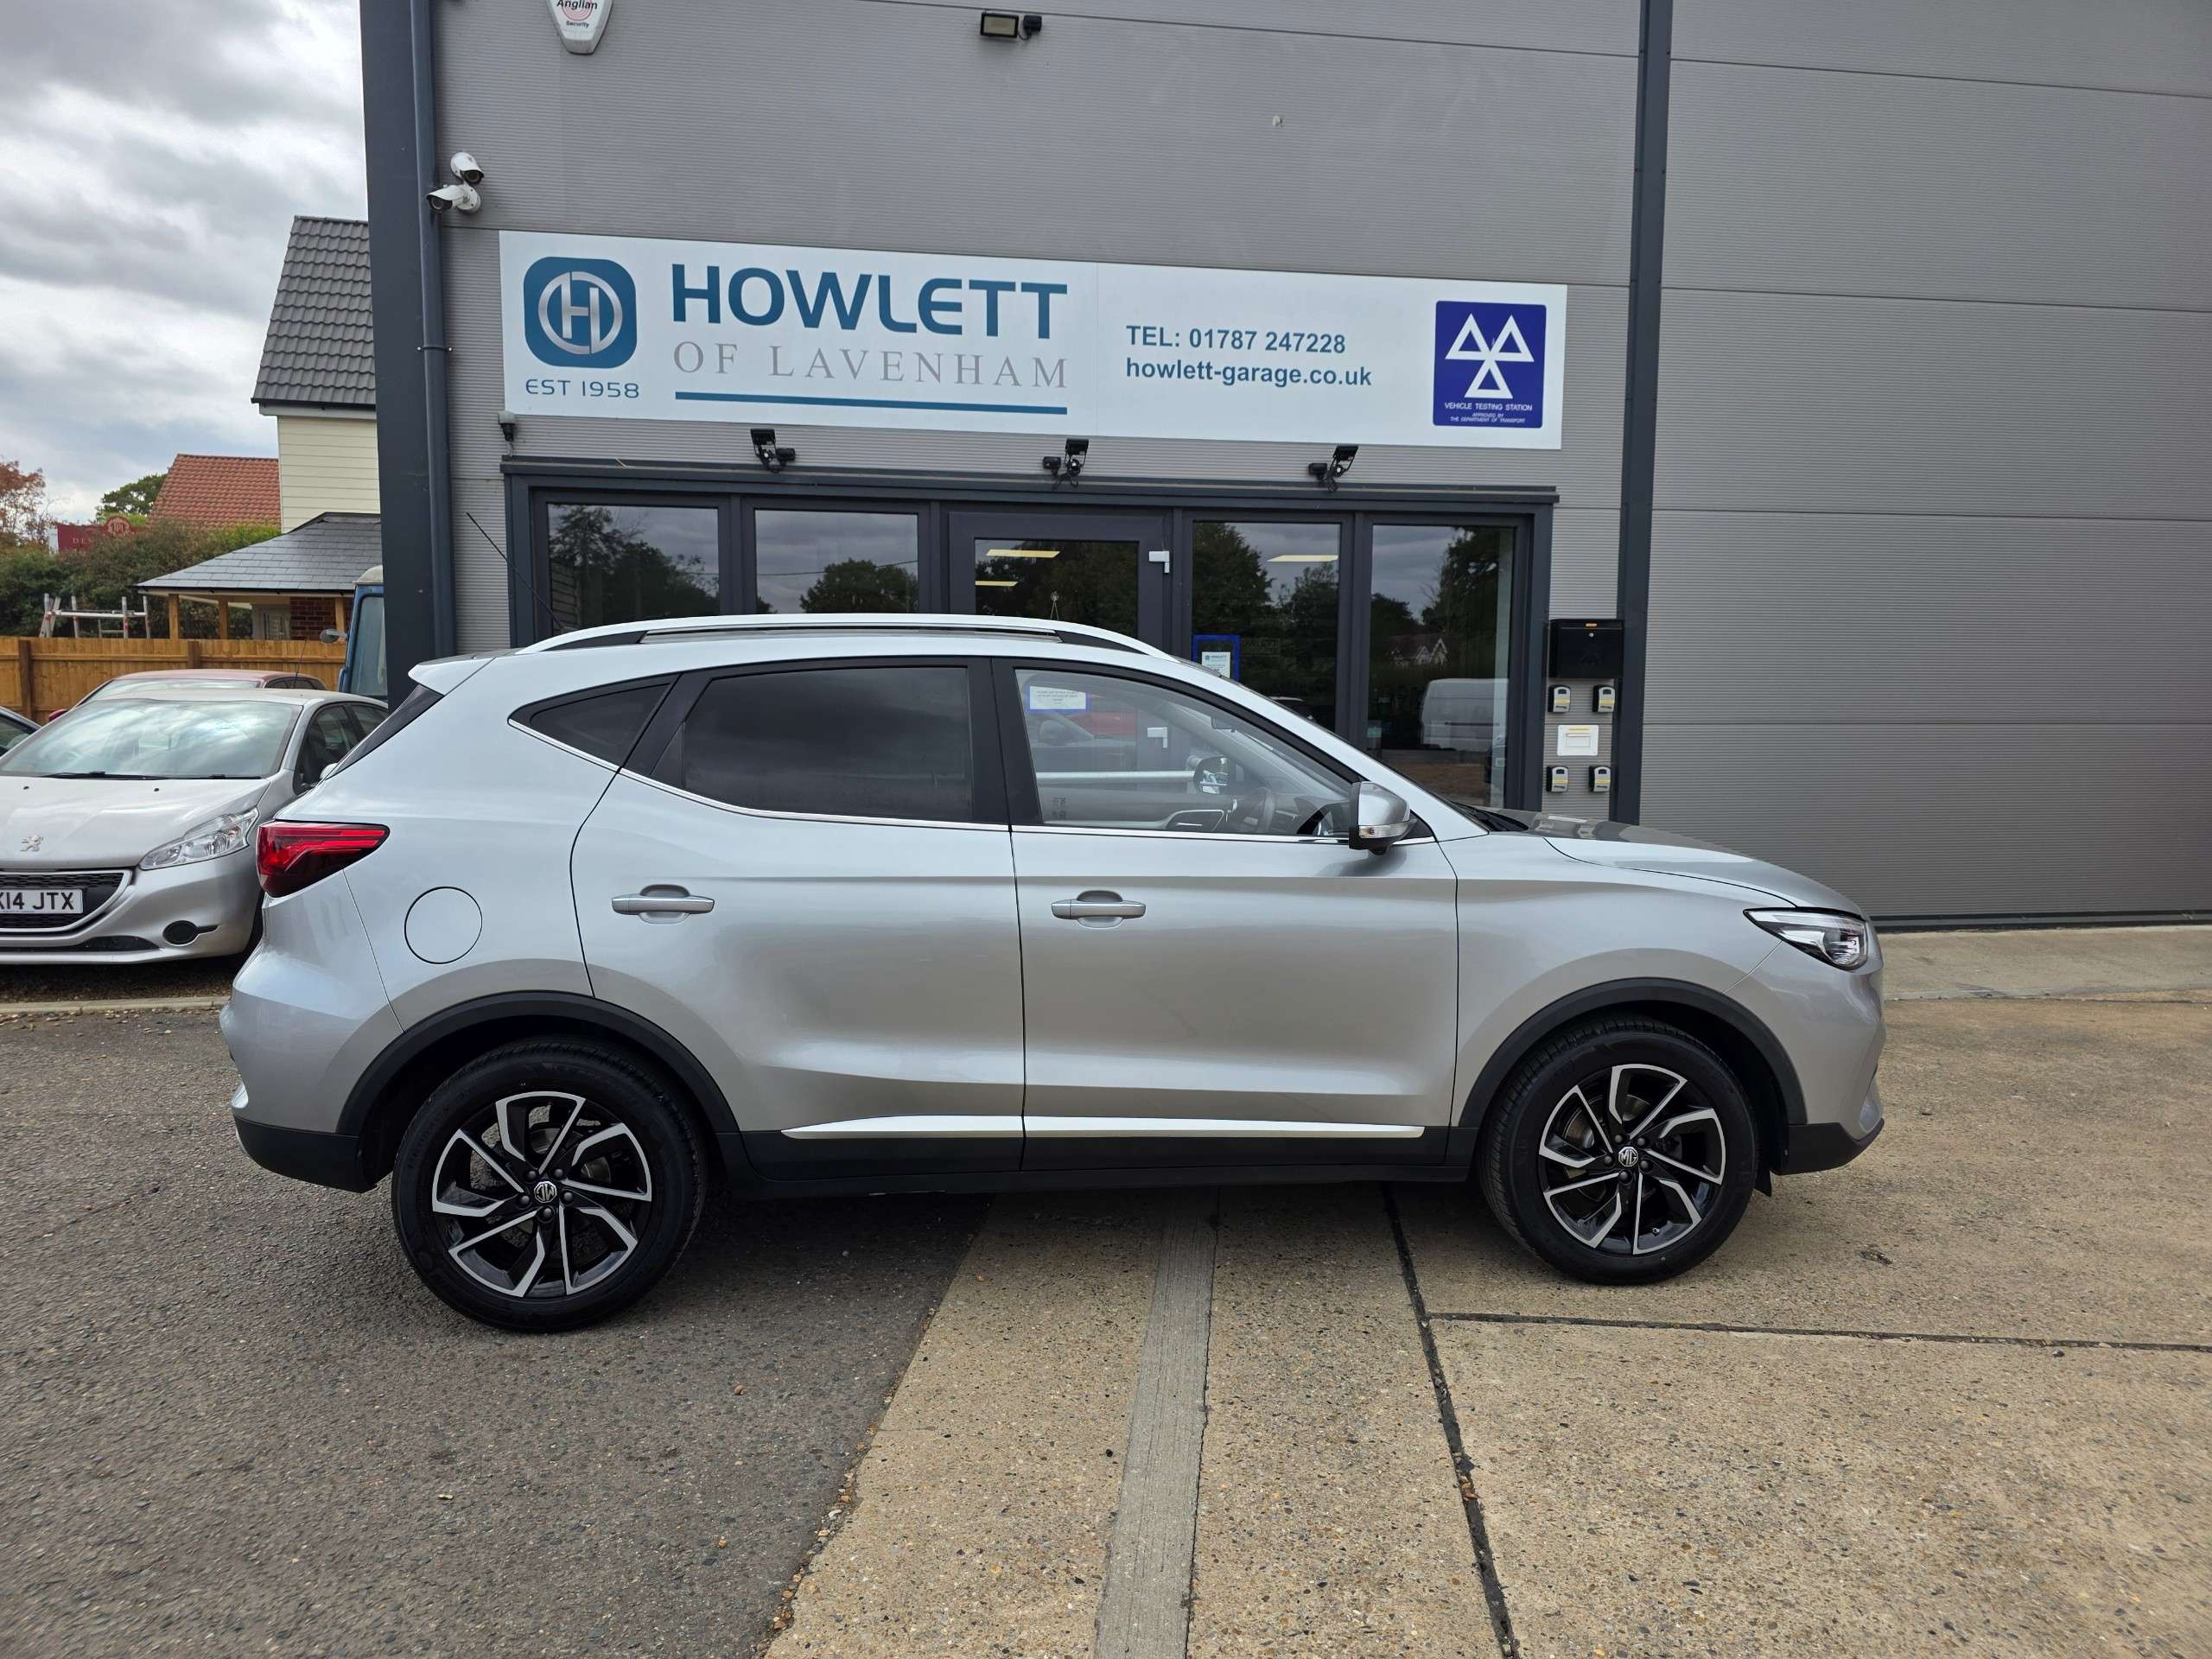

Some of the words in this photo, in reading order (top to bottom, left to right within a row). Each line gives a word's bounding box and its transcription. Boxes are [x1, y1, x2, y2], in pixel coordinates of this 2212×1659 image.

[556, 0, 598, 10] Anglian
[671, 263, 1068, 340] HOWLETT
[1126, 325, 1180, 347] TEL:
[1189, 327, 1257, 350] 01787
[1265, 331, 1346, 354] 247228
[673, 340, 739, 374] OF
[770, 345, 1068, 389] LAVENHAM
[1126, 357, 1372, 387] howlett-garage.co.uk
[525, 378, 571, 396] EST
[582, 380, 639, 399] 1958
[32, 892, 74, 910] JTX
